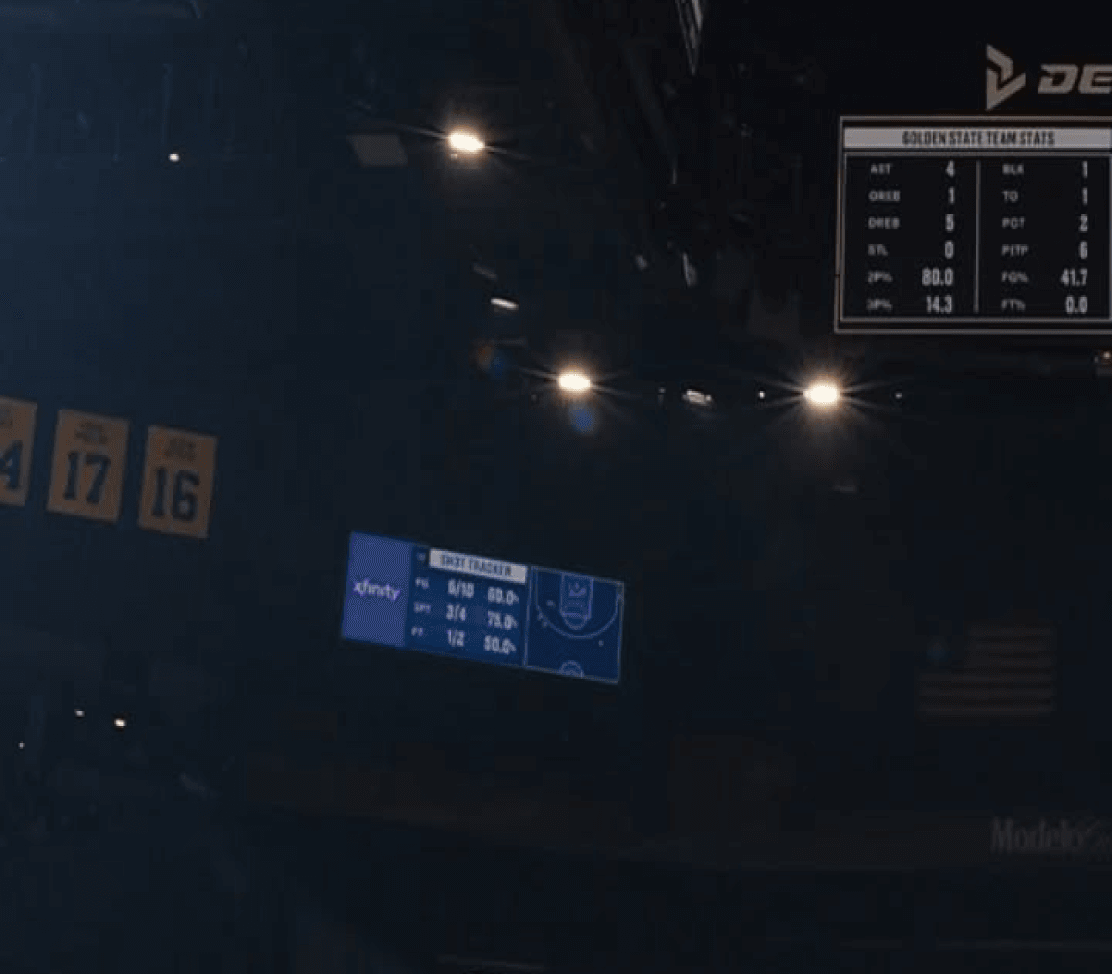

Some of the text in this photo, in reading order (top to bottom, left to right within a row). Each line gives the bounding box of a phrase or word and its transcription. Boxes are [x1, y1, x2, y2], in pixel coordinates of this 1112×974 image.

[902, 131, 1054, 145] GOLDEN STATE TEAM STATS
[945, 160, 955, 177] 4
[1081, 161, 1088, 178] 1
[947, 187, 955, 204] 1
[1081, 187, 1088, 205] 1
[945, 214, 955, 232] 5
[1079, 214, 1088, 232] 2
[945, 241, 954, 259] 0
[921, 267, 954, 286] 80.0
[1060, 267, 1088, 286] 41.7
[926, 295, 953, 314] 14.3
[1065, 296, 1088, 314] 0.0
[62, 451, 112, 505] 17
[151, 466, 201, 523] 16
[353, 578, 401, 601] xfinity
